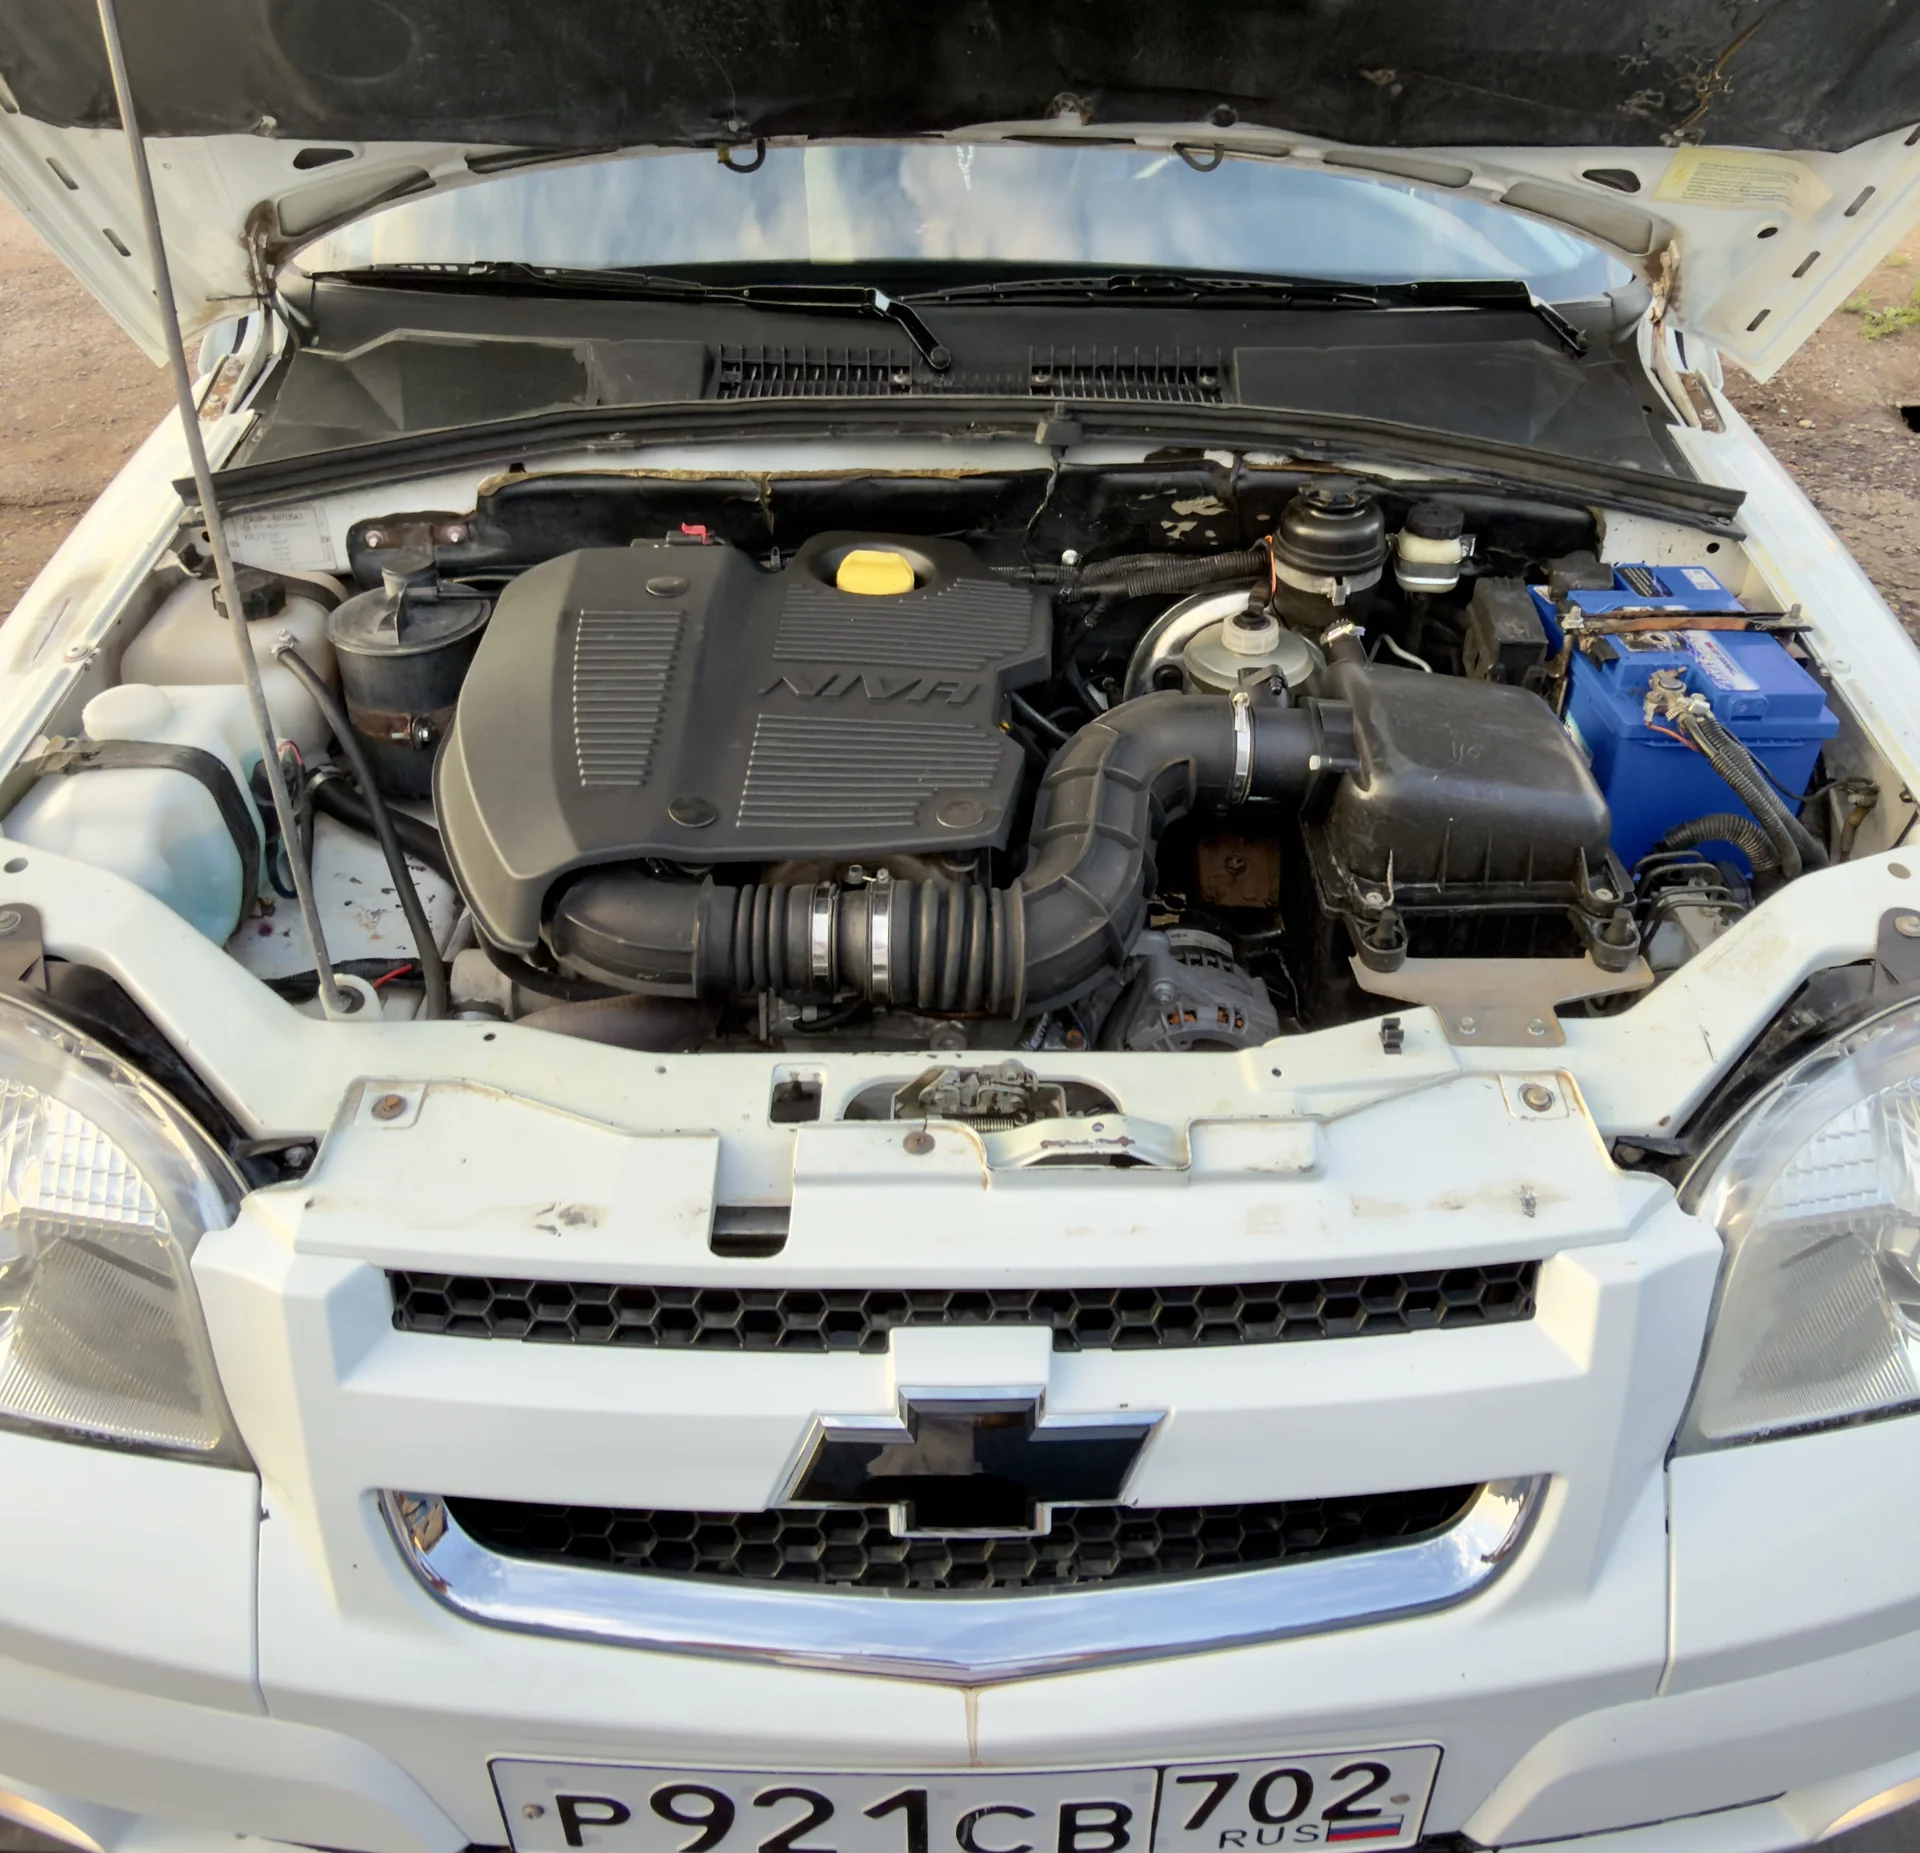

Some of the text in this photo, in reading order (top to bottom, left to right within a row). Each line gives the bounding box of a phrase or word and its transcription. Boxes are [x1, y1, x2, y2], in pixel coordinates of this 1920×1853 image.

[758, 673, 982, 706] NIVA
[1176, 1762, 1391, 1830] 702
[1219, 1824, 1320, 1849] RUS
